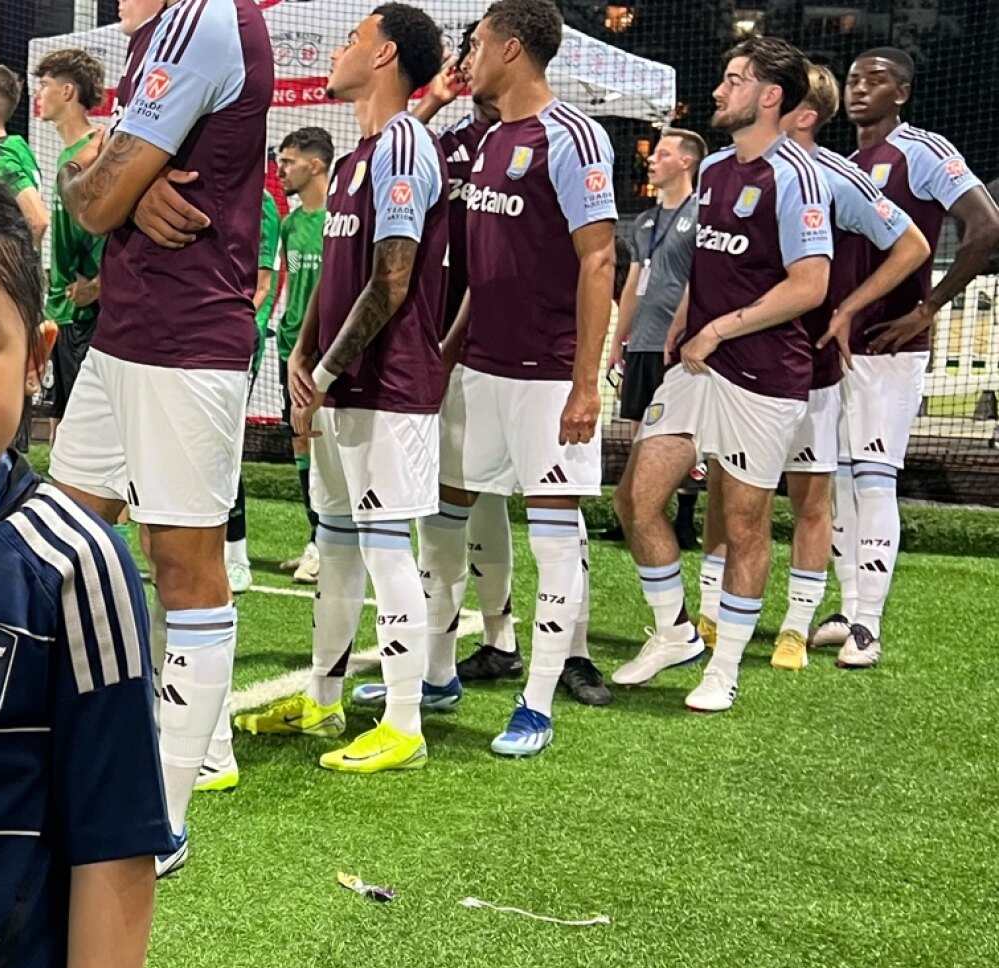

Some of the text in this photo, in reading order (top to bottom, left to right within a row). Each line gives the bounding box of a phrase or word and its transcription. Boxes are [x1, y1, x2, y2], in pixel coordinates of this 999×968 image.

[273, 86, 325, 103] NG KO
[696, 224, 750, 255] etano
[539, 593, 566, 604] 874
[377, 614, 408, 625] 874
[166, 651, 188, 667] 74
